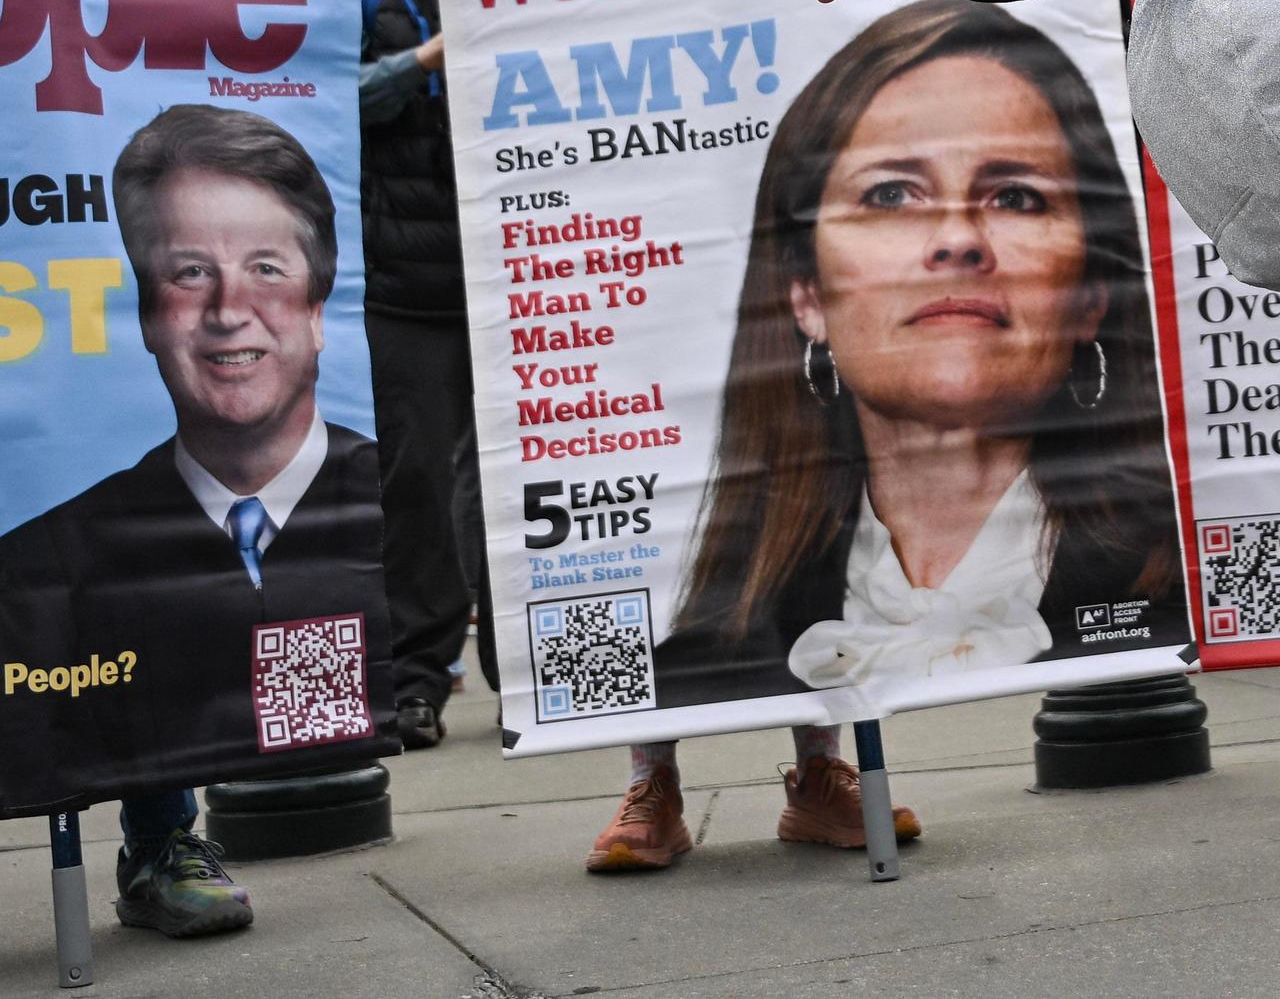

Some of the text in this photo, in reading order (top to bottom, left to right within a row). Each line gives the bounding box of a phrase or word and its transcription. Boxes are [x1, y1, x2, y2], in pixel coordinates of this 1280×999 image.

[208, 76, 317, 101] Magazine
[483, 17, 780, 131] AMY!
[496, 117, 771, 173] She's BANtastic
[500, 190, 571, 213] PLUS:
[501, 212, 642, 249] Finding
[504, 241, 684, 284] The Right
[508, 281, 648, 319] Man To
[510, 320, 615, 354] Make
[512, 362, 599, 390] Your
[517, 383, 665, 427] Medical
[520, 424, 681, 462] Decisons
[524, 473, 660, 550] 5 EASY
[574, 507, 652, 541] TIPS
[528, 543, 660, 572] To Master the
[531, 565, 643, 590] Blank Stare
[1082, 608, 1105, 624] AAF
[1112, 600, 1149, 610] ABORTION
[1113, 607, 1141, 617] ACCESS
[1114, 615, 1138, 624] FRONT
[1081, 626, 1151, 643] aafront.org
[3, 650, 138, 698] People?
